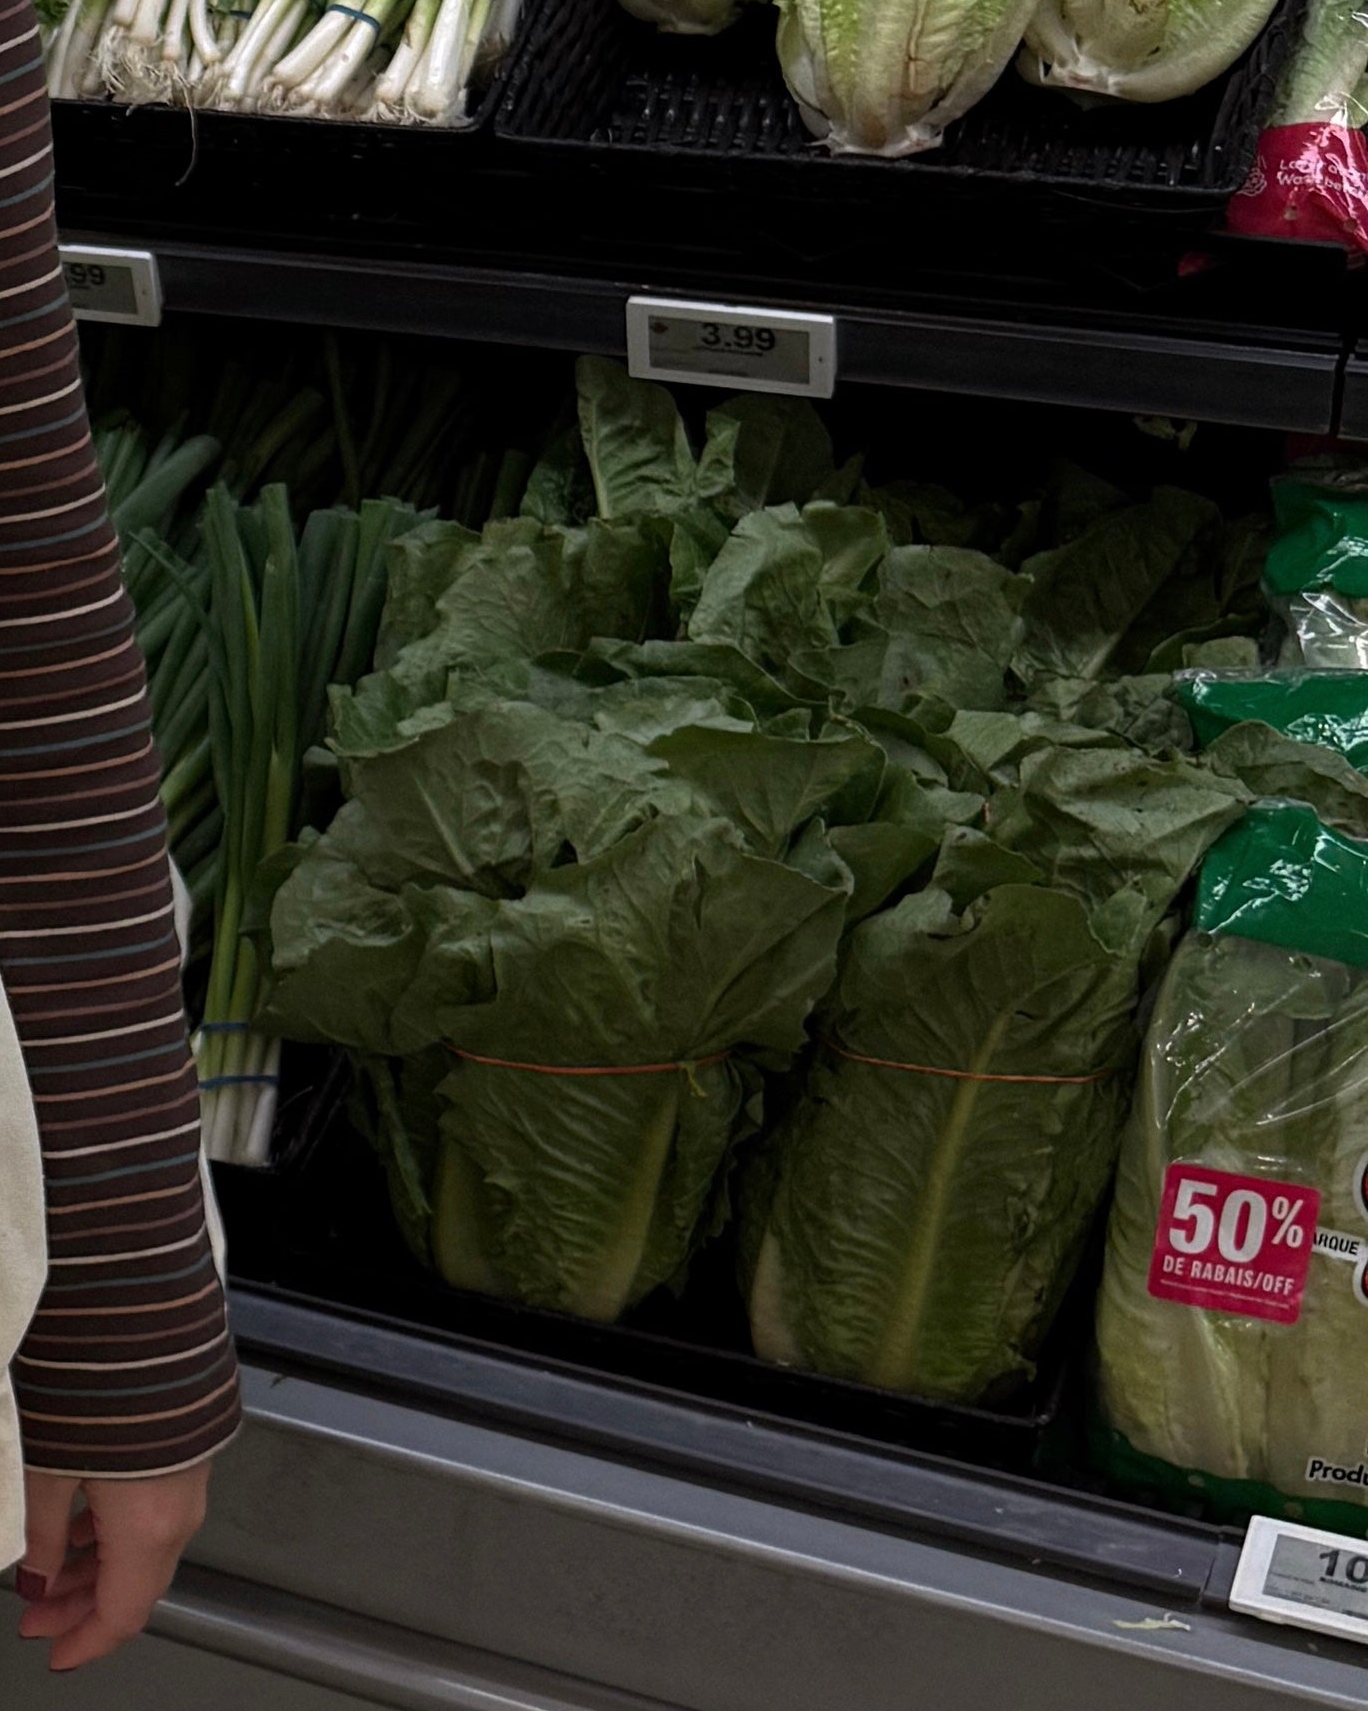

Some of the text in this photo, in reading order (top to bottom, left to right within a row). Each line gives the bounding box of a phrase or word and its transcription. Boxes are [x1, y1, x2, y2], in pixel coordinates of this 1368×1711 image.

[701, 322, 776, 351] 3.99
[1169, 1178, 1305, 1264] 50%
[1163, 1254, 1295, 1297] DE RABAIS/OFF
